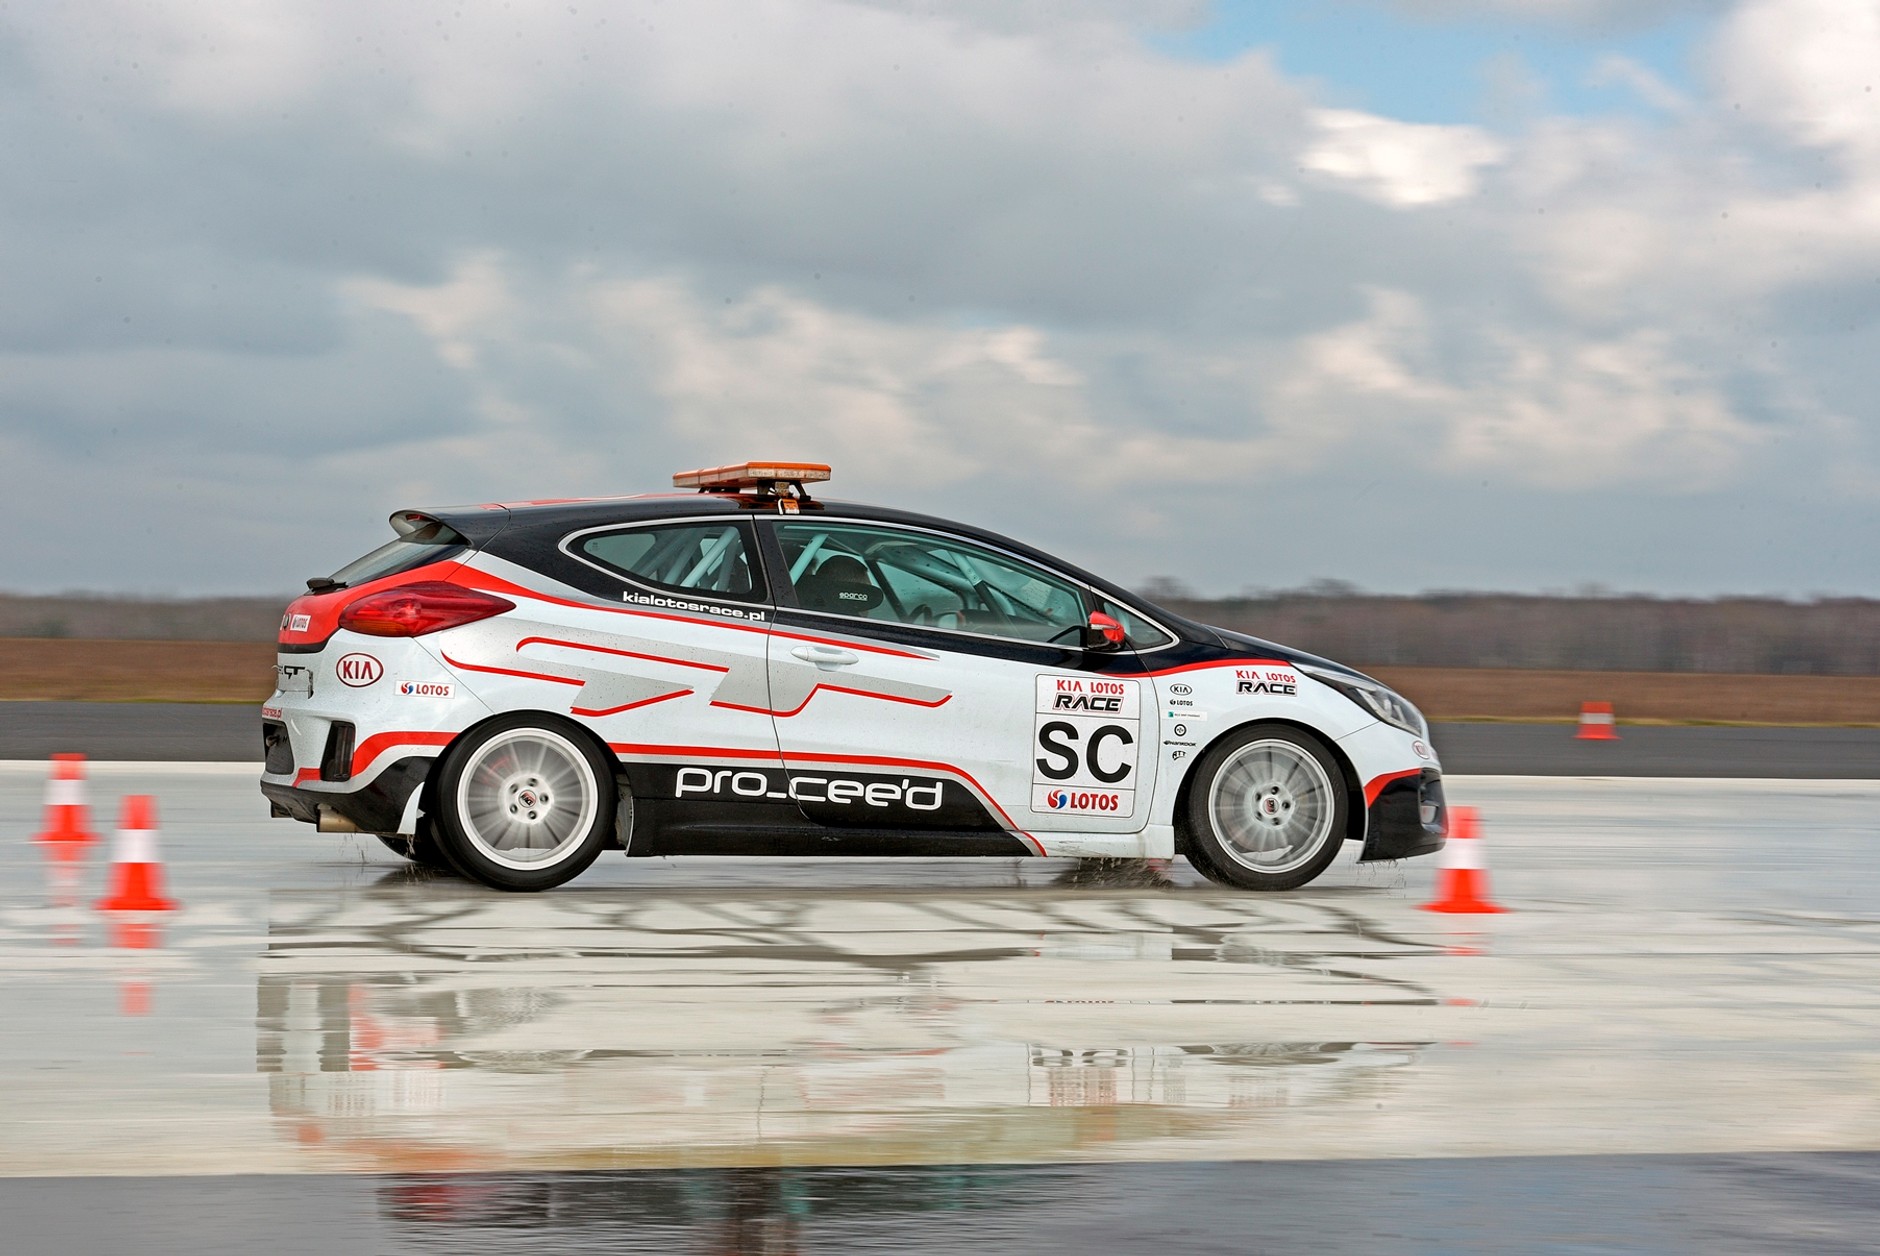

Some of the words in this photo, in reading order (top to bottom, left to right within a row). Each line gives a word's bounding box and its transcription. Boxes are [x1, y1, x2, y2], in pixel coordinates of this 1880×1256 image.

[839, 591, 868, 602] sparco
[622, 591, 765, 622] kialotosrace.pl
[342, 660, 374, 680] KIA
[1235, 669, 1260, 680] KIA
[1266, 672, 1296, 684] LOTOS
[415, 683, 449, 696] LOTOS
[1056, 679, 1083, 692] KIA
[1090, 681, 1124, 695] LOTOS
[1173, 686, 1189, 694] KIA
[1238, 681, 1296, 696] RACE
[1054, 694, 1122, 712] RACE
[1176, 699, 1193, 707] LOTOS
[1036, 720, 1134, 784] SC
[1070, 792, 1119, 811] LOTOS
